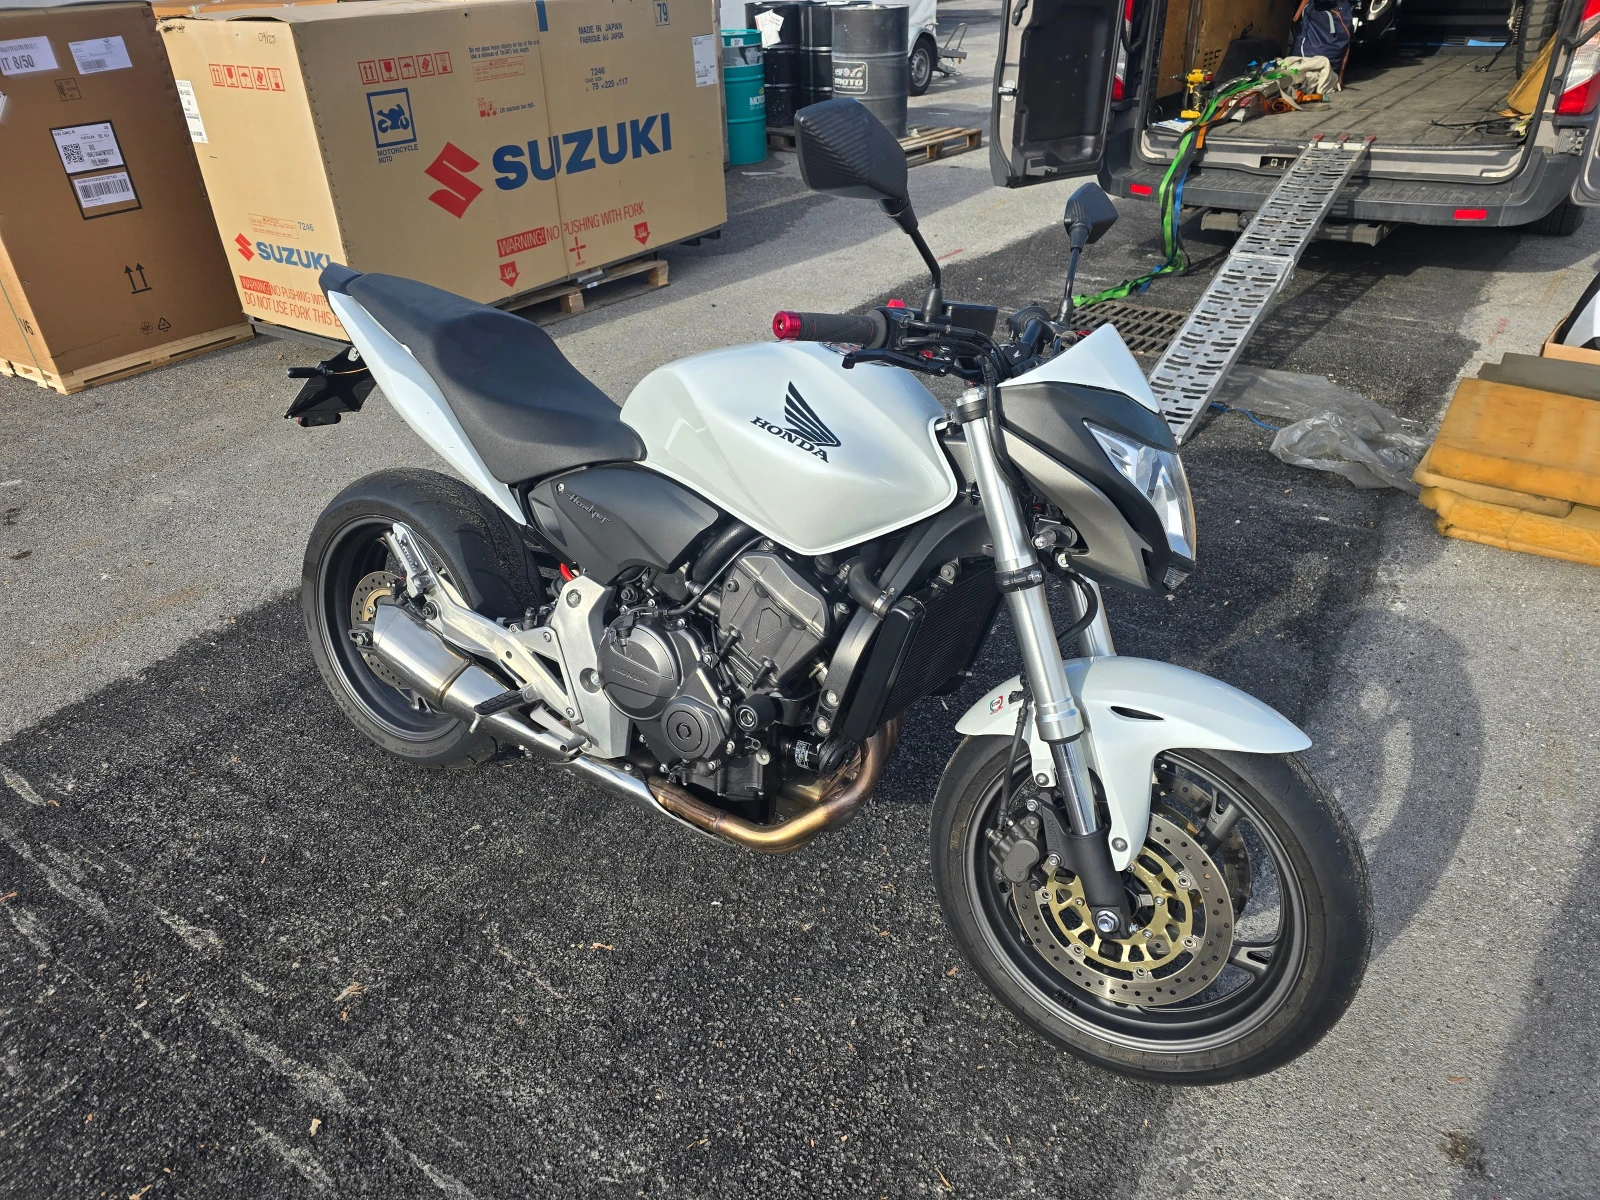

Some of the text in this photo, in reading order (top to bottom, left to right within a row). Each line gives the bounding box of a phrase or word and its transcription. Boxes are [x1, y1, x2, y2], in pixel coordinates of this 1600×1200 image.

[578, 22, 623, 35] MADE IN JAPAN
[579, 32, 624, 44] FABRIQUE AU JAPON
[12, 54, 35, 70] 8/50
[590, 67, 605, 76] 7246
[377, 143, 419, 157] MOTORCYCLE
[492, 112, 672, 191] SUZUKI
[378, 156, 393, 164] MOTO
[297, 221, 314, 232] 7246
[499, 229, 546, 255] WARNING!
[546, 225, 560, 242] NO
[600, 207, 623, 226] WITH
[623, 201, 645, 220] FORK
[240, 277, 273, 295] WARNING!
[271, 284, 281, 297] NO
[281, 286, 311, 303] PUSHING
[243, 291, 256, 307] DO
[257, 295, 272, 310] NOT
[272, 299, 289, 316] USE
[289, 303, 312, 321] FORK
[312, 308, 333, 326] THIS
[750, 415, 829, 464] HONDA
